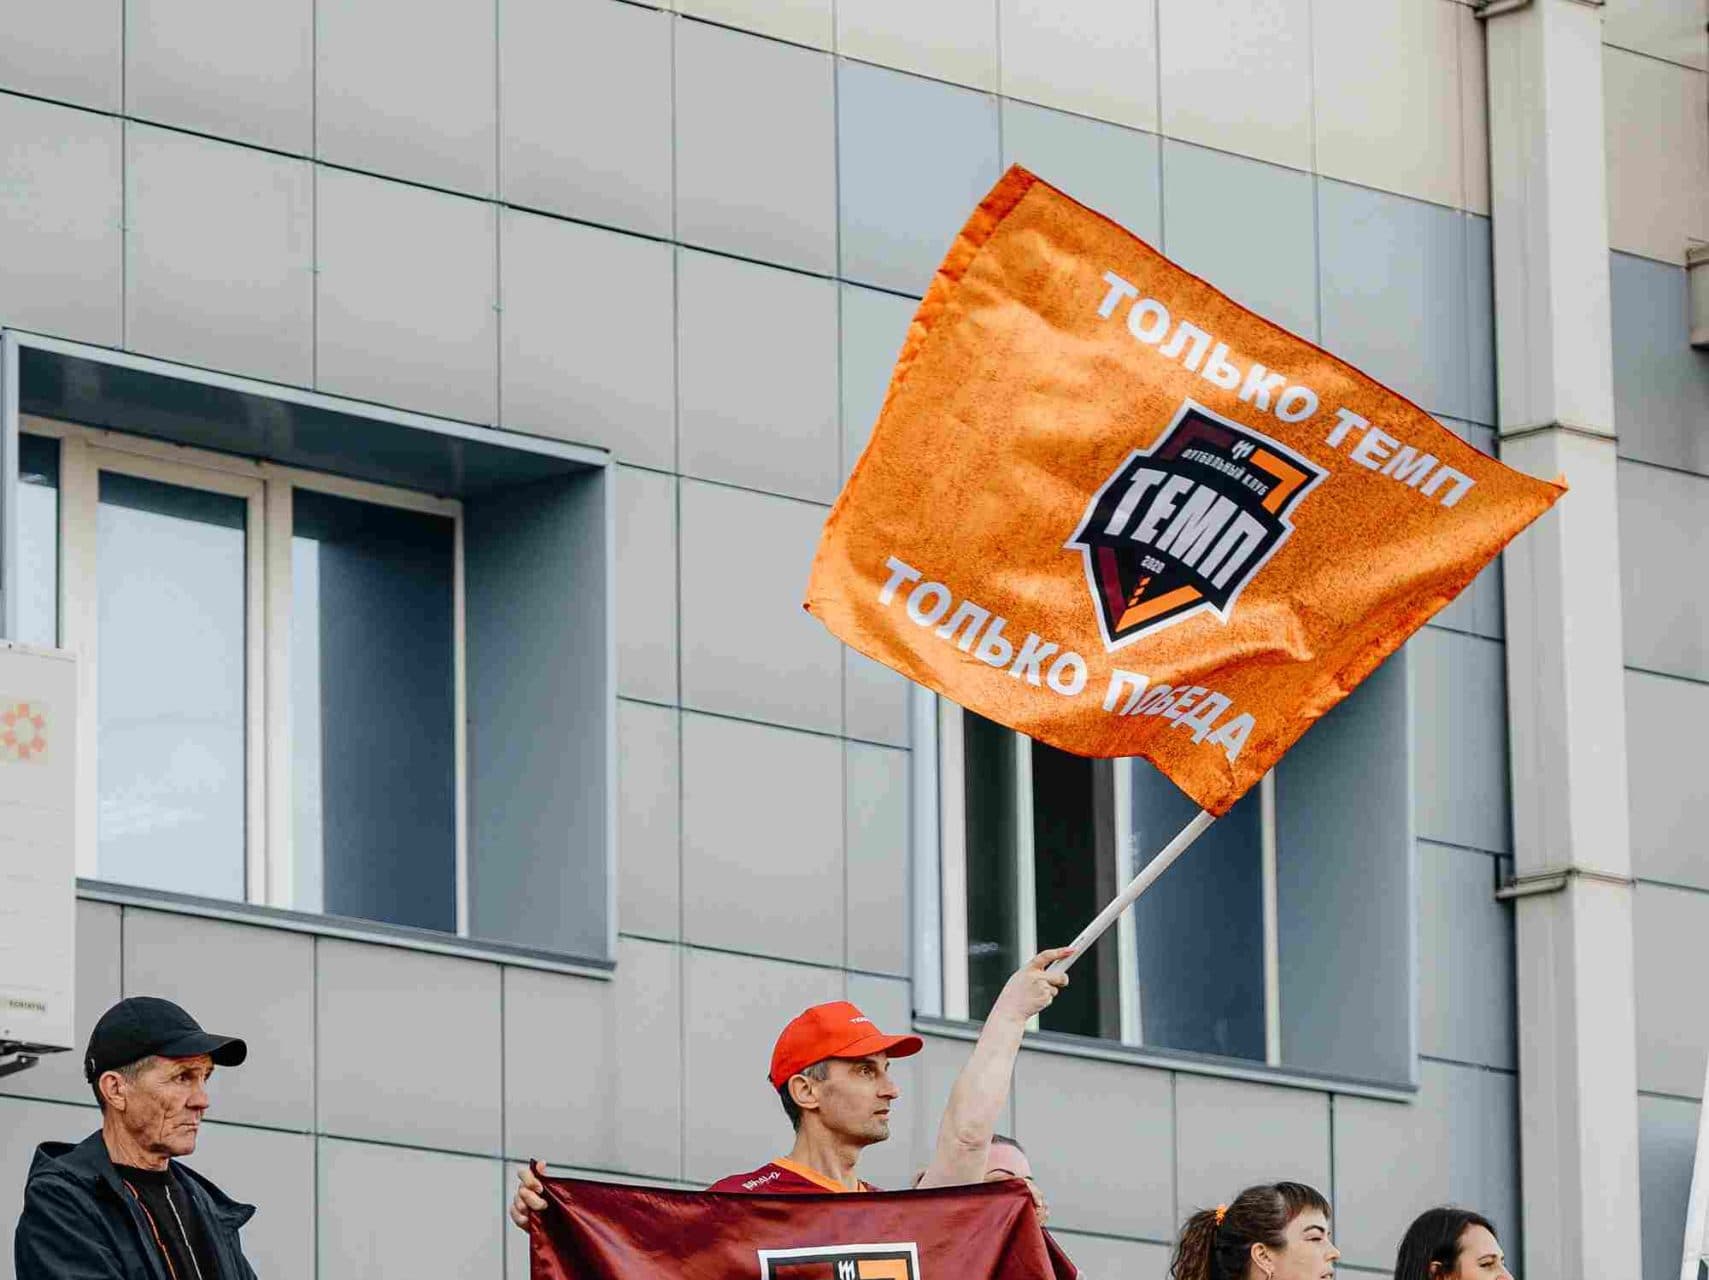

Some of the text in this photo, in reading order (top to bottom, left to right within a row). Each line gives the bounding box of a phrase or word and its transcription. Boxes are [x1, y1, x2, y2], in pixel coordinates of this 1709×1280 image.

[1096, 271, 1478, 509] ТОЛЬКО ТЕМП
[1103, 467, 1269, 591] ТЕМП
[1242, 474, 1270, 497] КЛУБ
[877, 556, 1257, 763] ТОЛЬКО ПОБЕДА
